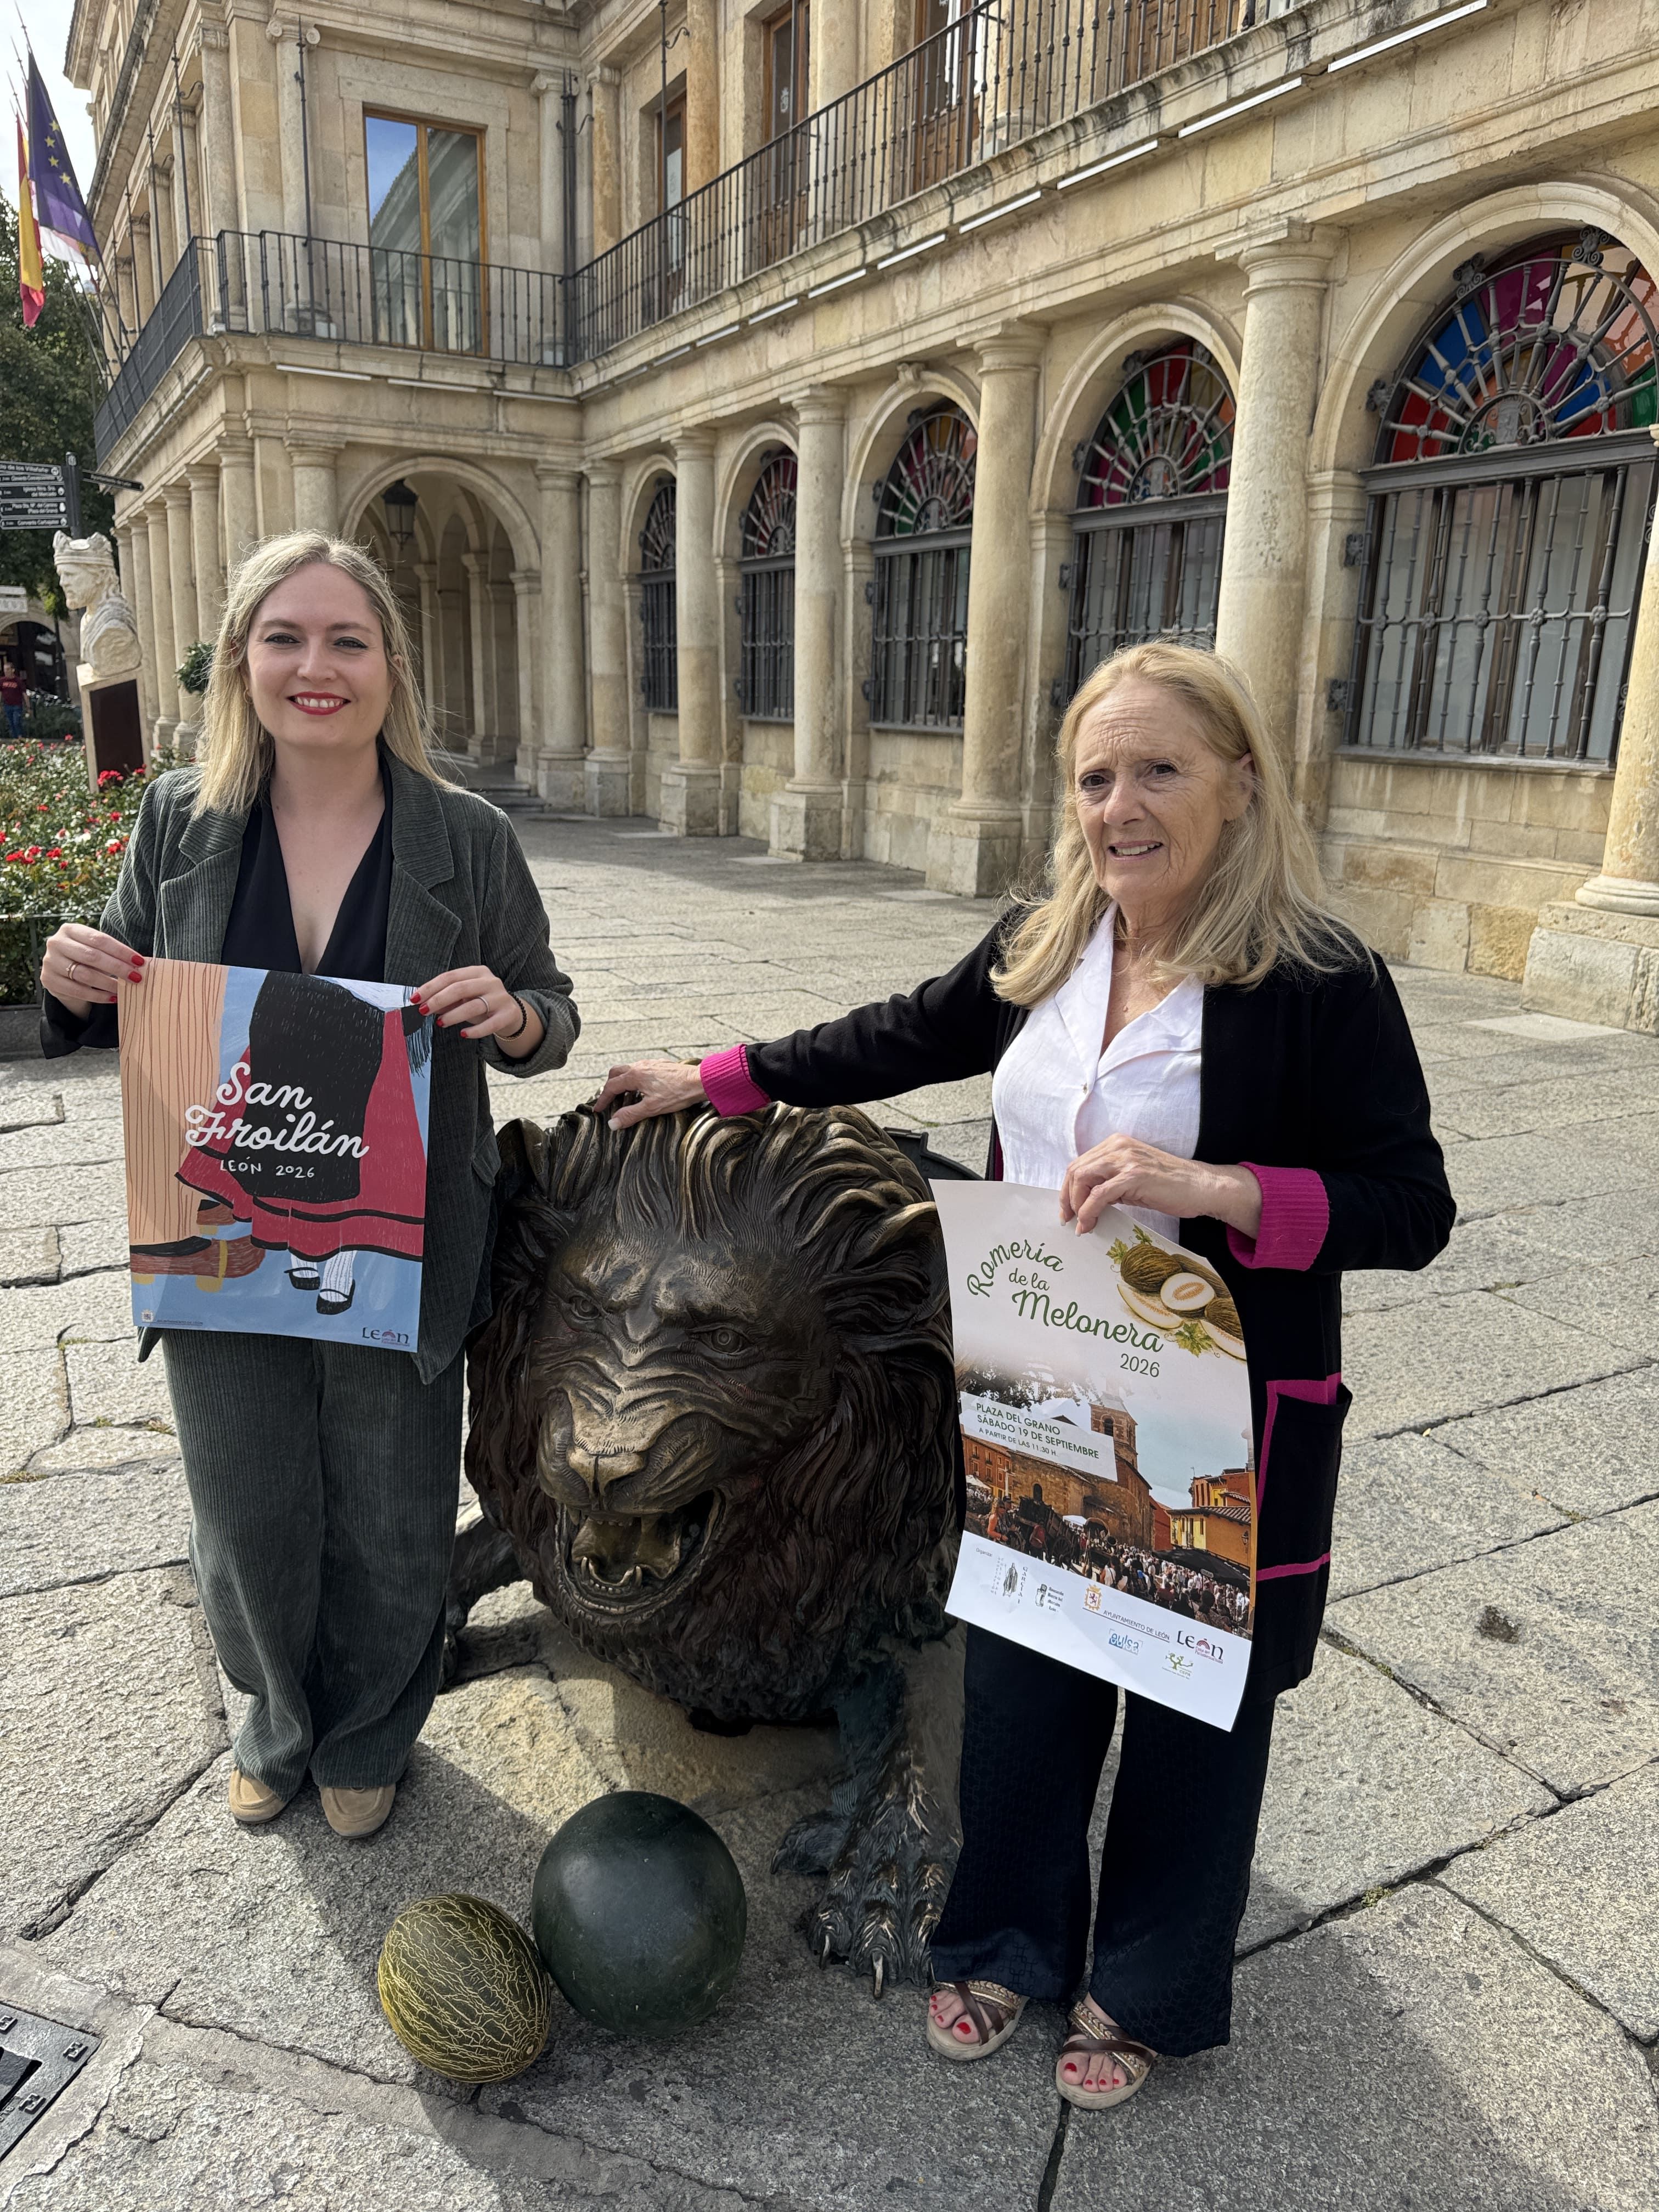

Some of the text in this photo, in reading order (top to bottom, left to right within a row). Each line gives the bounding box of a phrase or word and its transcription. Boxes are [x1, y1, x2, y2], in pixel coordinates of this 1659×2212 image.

[216, 1062, 313, 1110] San
[185, 1104, 370, 1159] Froilán
[219, 1156, 315, 1179] LEÓN 2026
[967, 1239, 1064, 1298] Romería
[1008, 1267, 1050, 1291] de la
[1011, 1289, 1164, 1353] Melonera
[1119, 1353, 1160, 1378] 2026
[976, 1402, 1060, 1435] PLAZA DEL GRANO
[977, 1414, 1099, 1459] SÁBADO 19 DE SEPTIEMBRE
[985, 1429, 1007, 1441] PARTIR
[1008, 1435, 1017, 1443] DE
[1018, 1438, 1030, 1448] LAS
[1031, 1443, 1050, 1454] 11:30
[1103, 1610, 1170, 1640] AYUNTAMIENTO DE LEÓN
